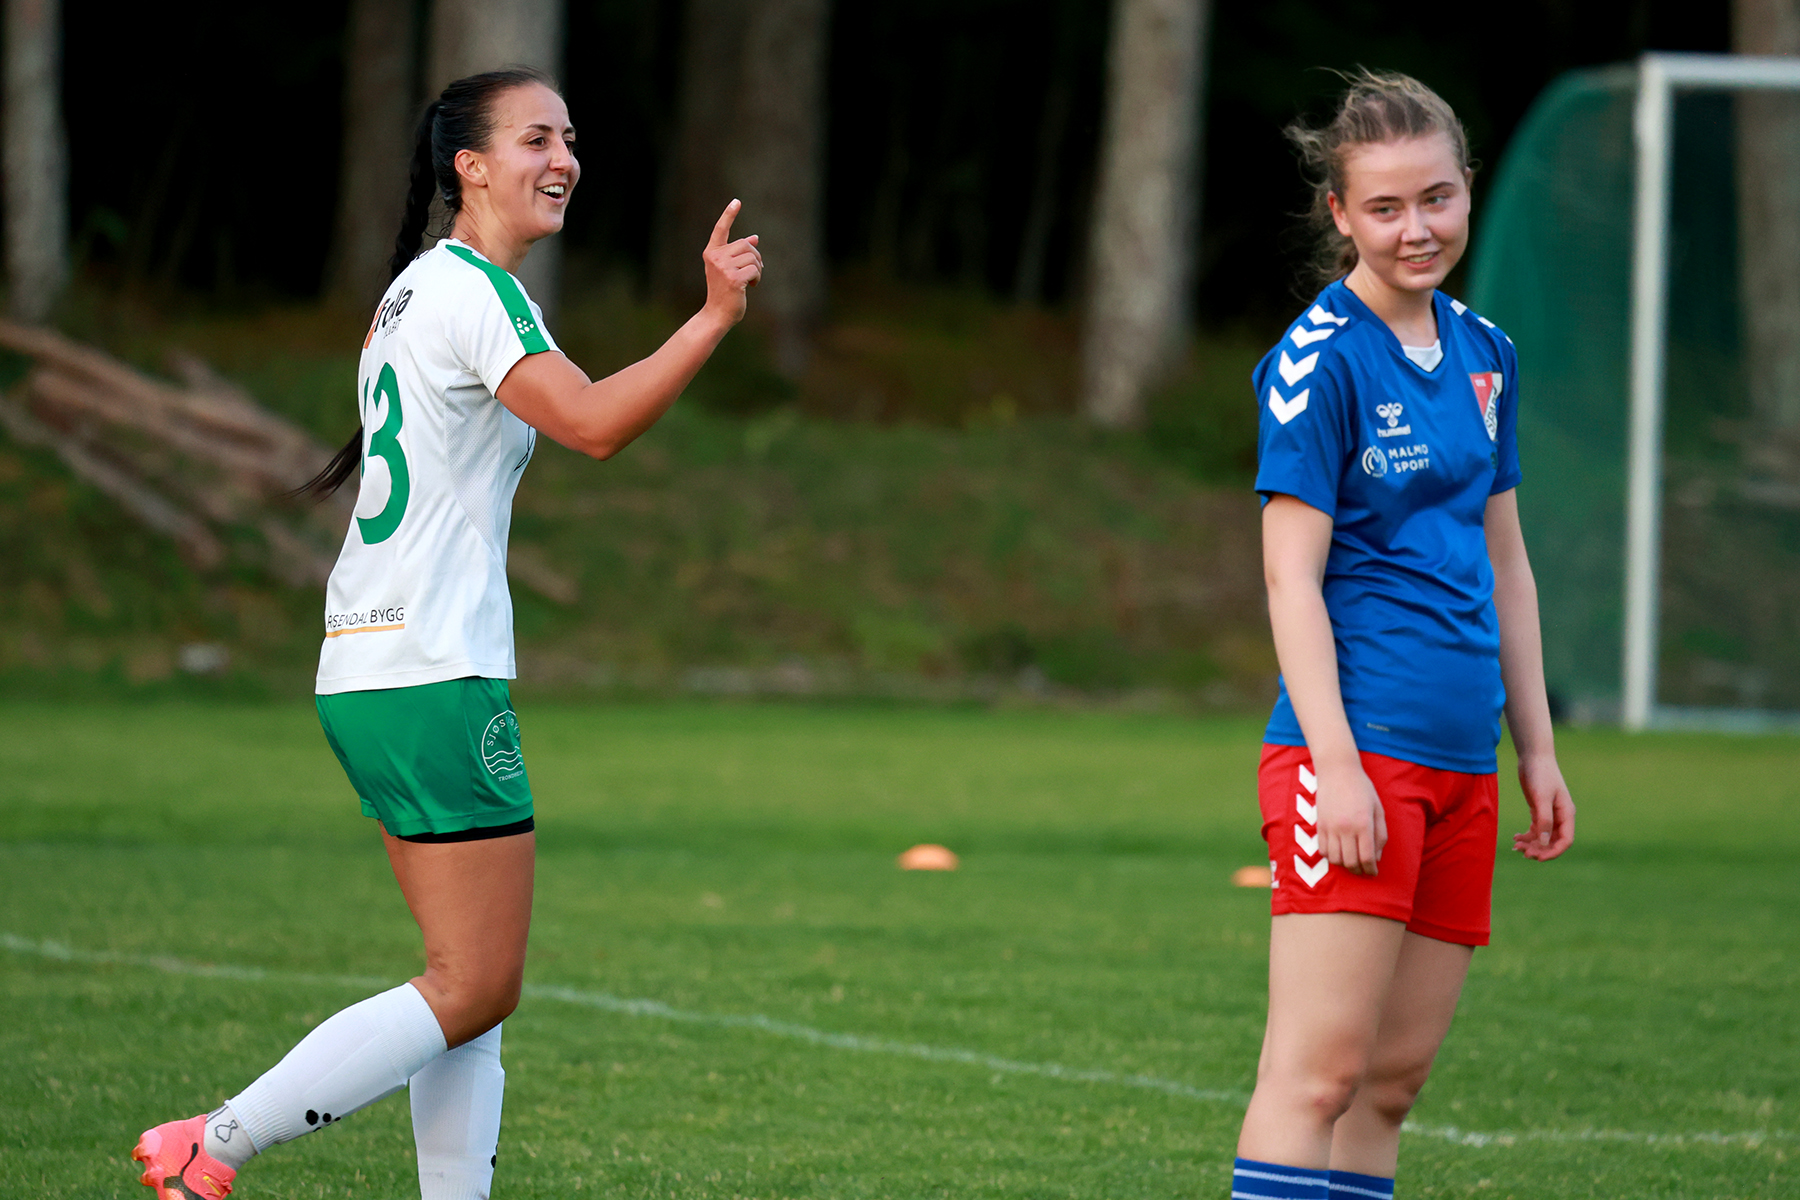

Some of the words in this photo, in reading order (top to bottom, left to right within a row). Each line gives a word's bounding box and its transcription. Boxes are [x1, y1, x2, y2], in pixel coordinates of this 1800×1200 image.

[356, 362, 410, 545] 3
[1393, 458, 1430, 473] SPORT
[369, 607, 404, 623] BYGG
